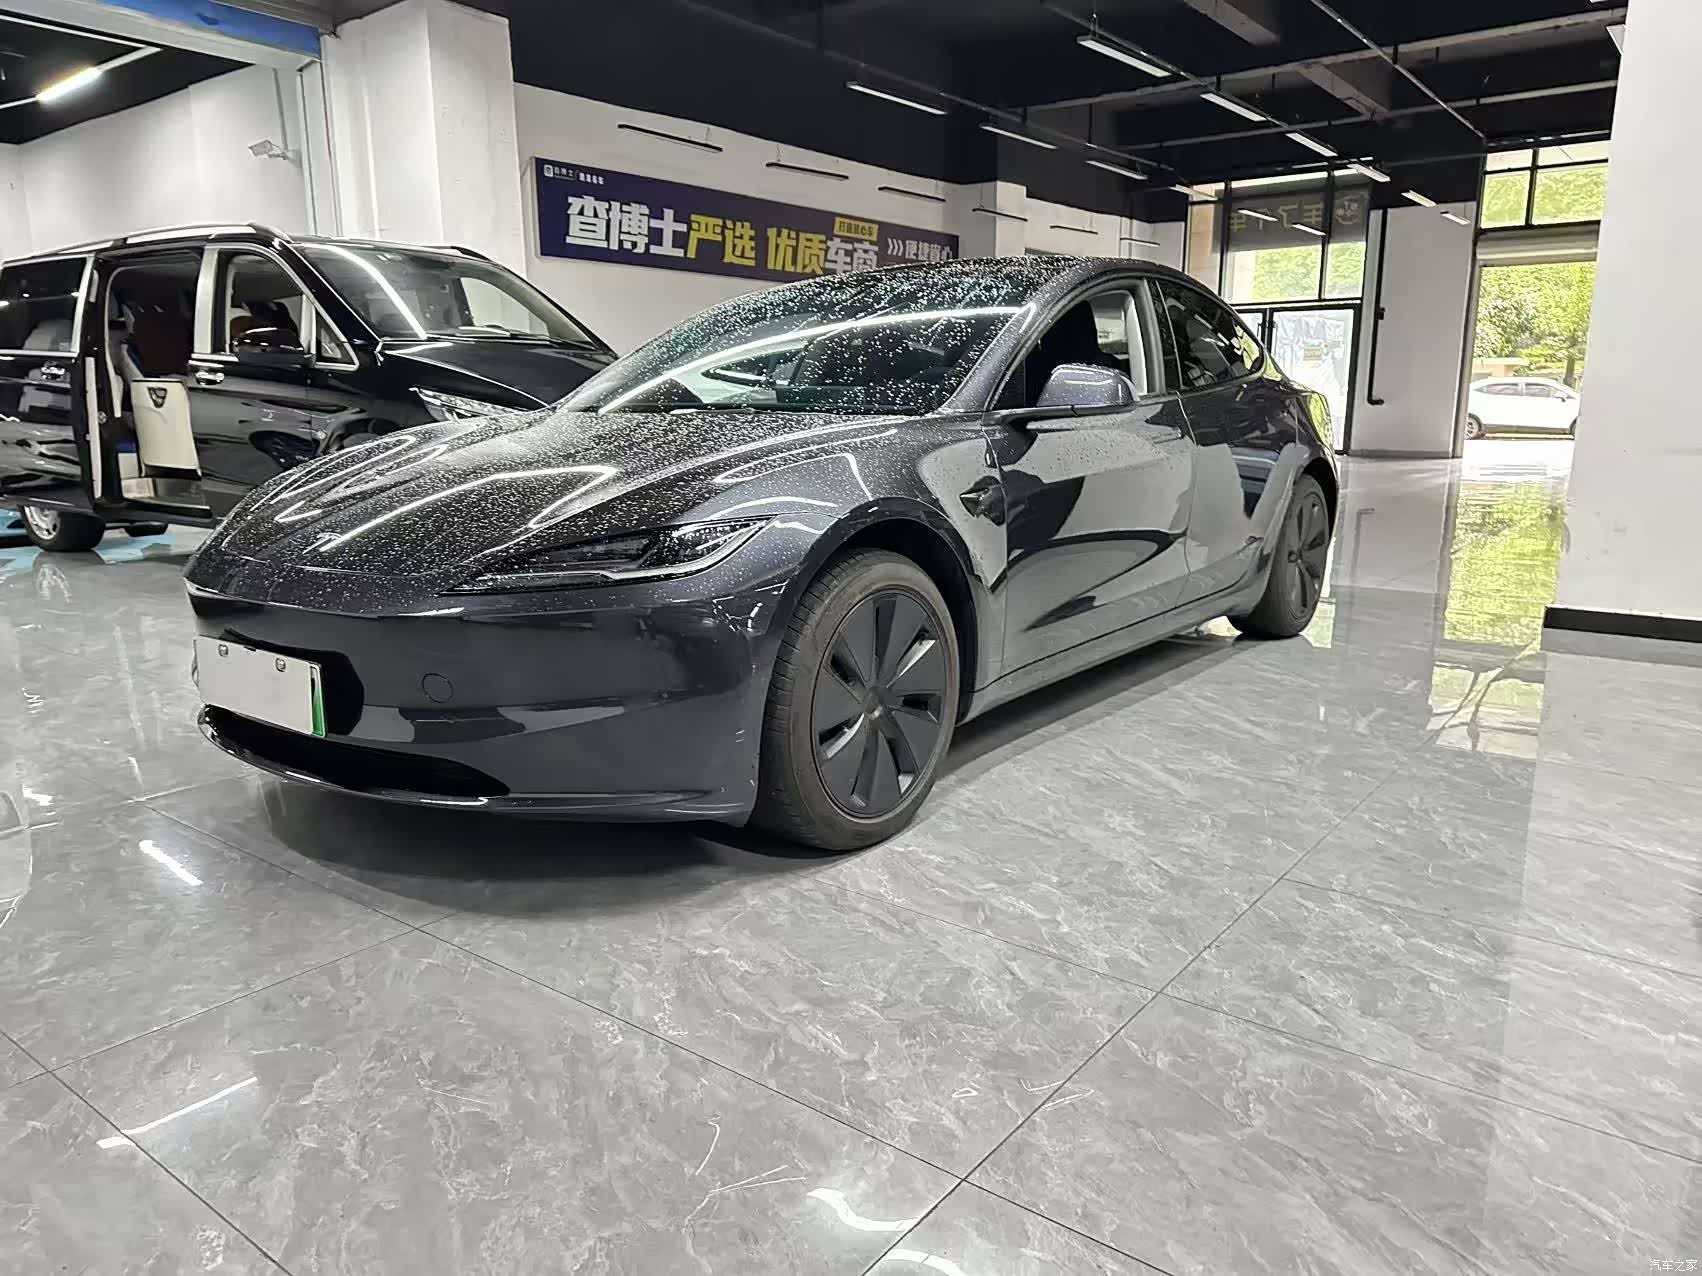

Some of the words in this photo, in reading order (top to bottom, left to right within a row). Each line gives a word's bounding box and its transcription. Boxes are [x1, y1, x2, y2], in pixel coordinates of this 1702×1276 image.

[565, 195, 756, 267] 查博士严选
[767, 226, 879, 274] 优质车商
